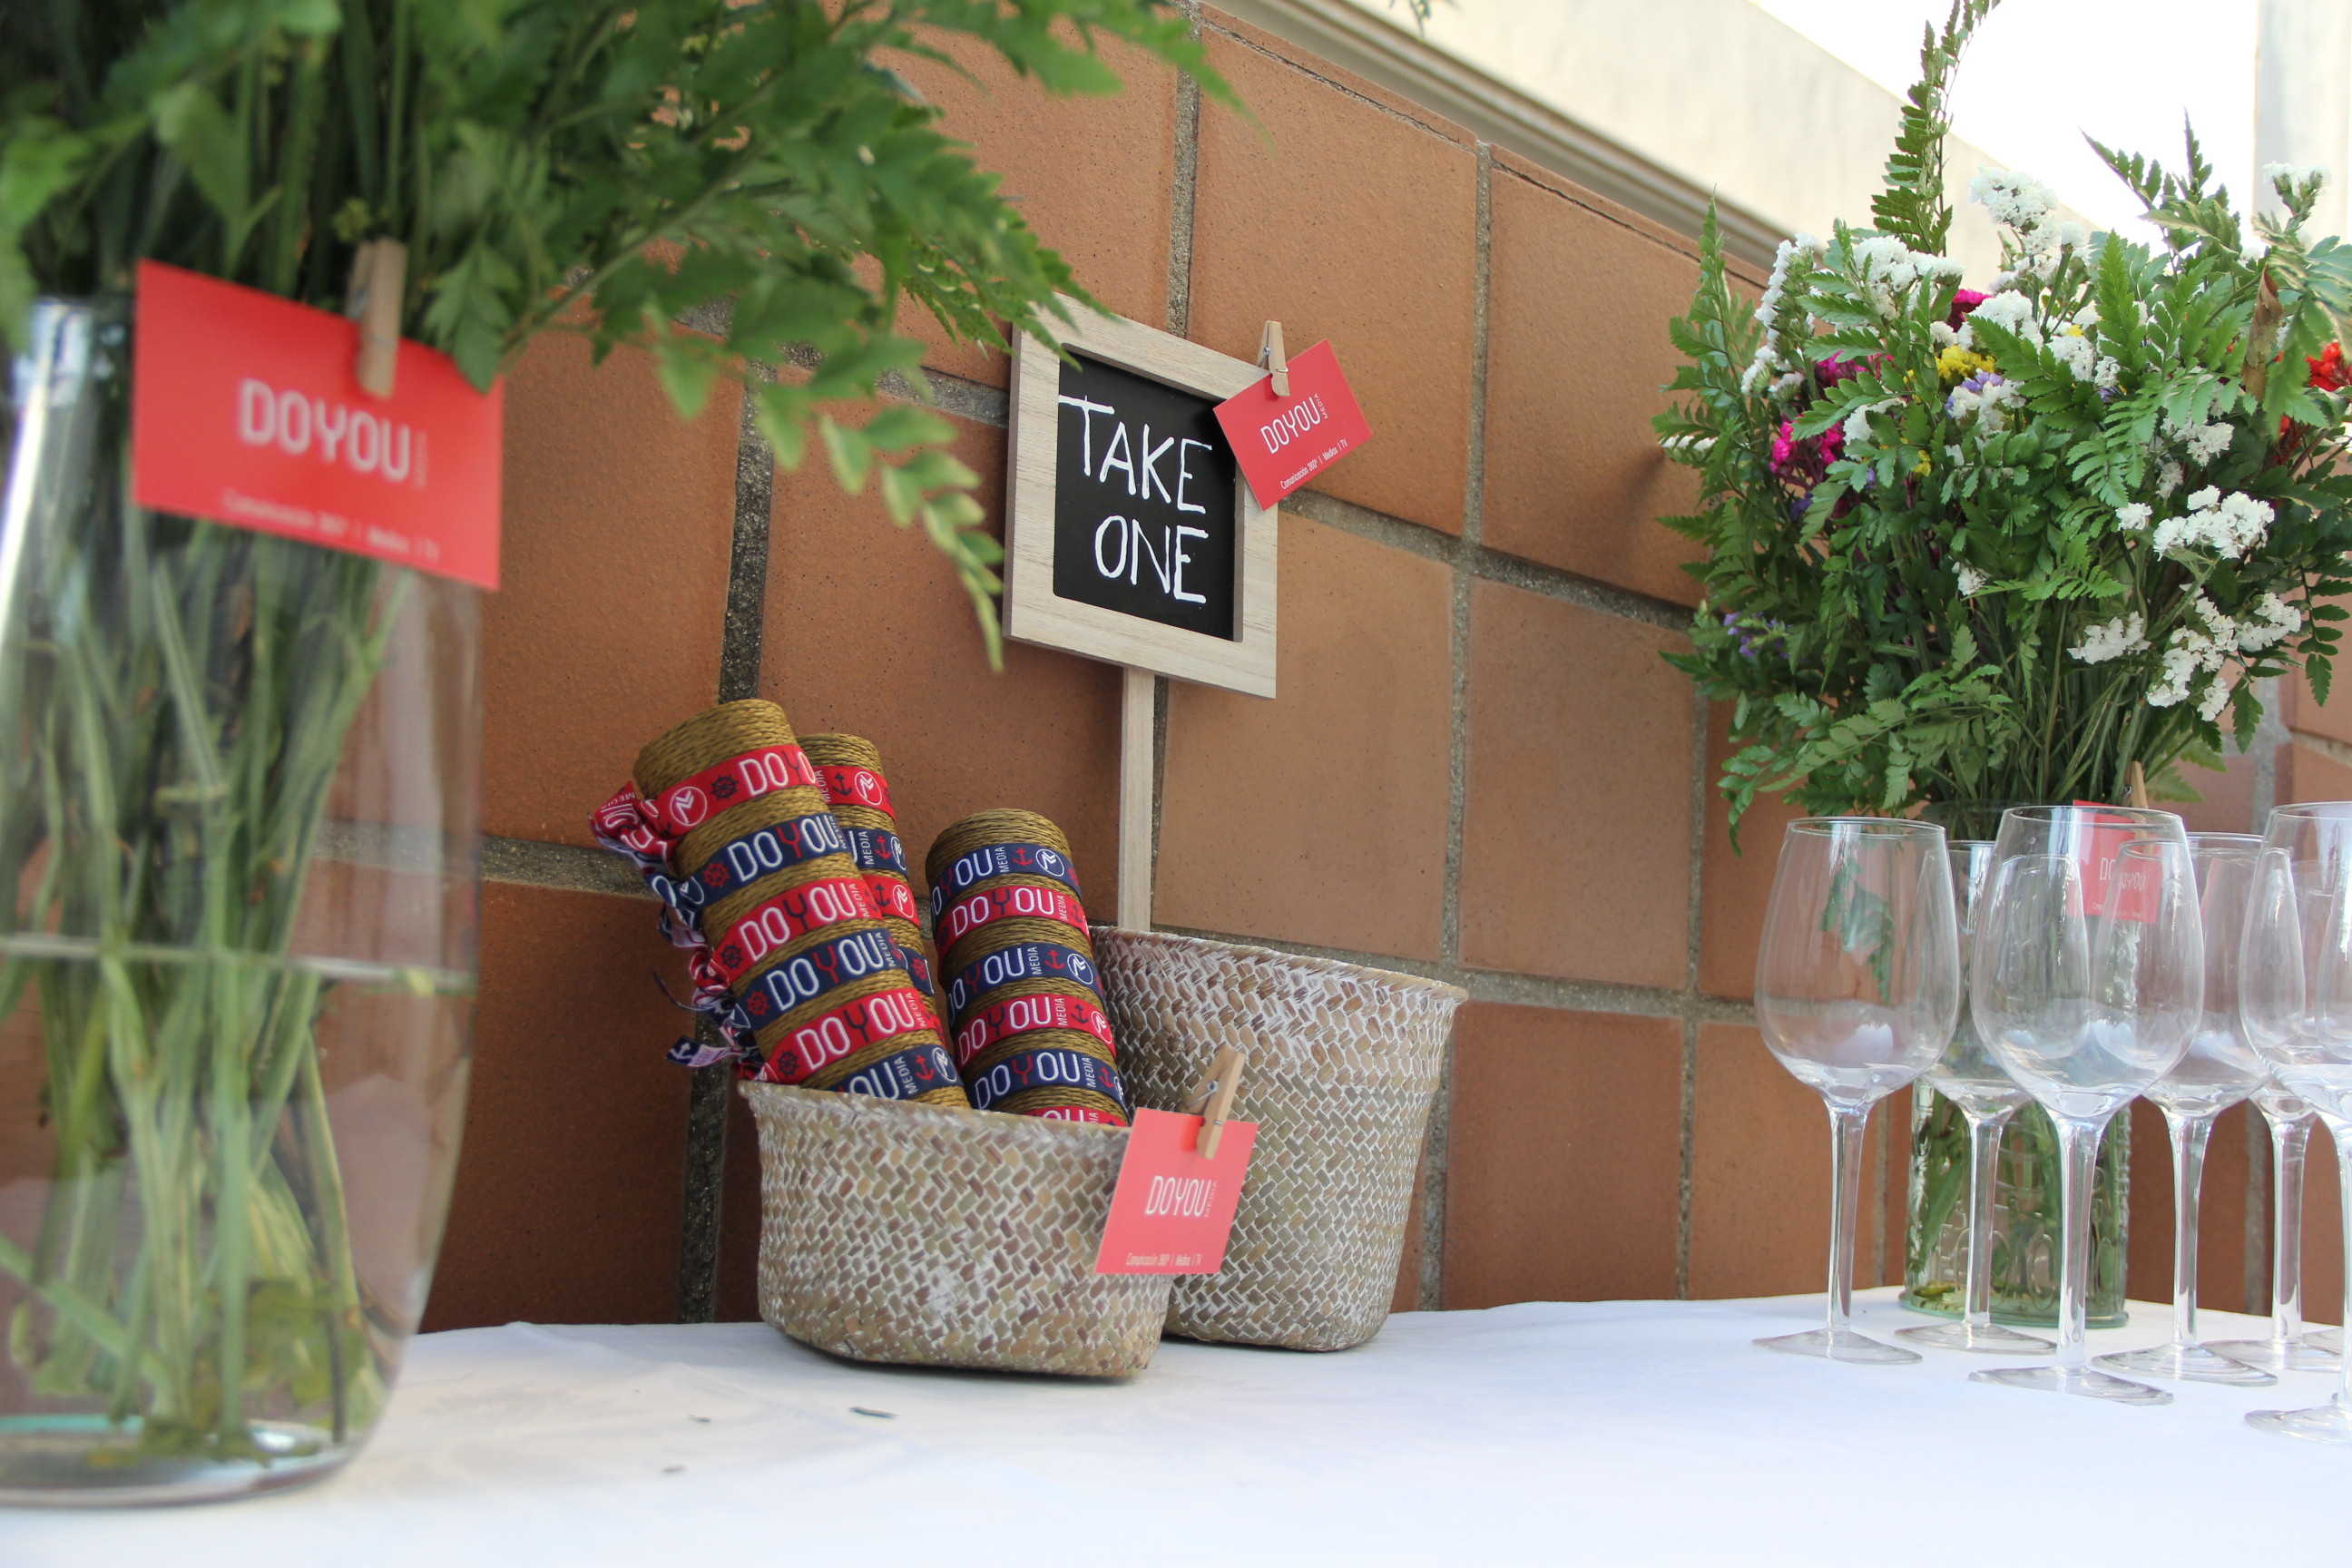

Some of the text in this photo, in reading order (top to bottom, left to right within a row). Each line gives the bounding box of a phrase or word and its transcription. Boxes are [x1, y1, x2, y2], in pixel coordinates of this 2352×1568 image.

[240, 377, 411, 483] DOYOU
[1260, 397, 1321, 454] DOYOU
[1059, 395, 1212, 514] TAKE
[1095, 515, 1209, 603] ONE
[739, 750, 816, 796] DOYO
[727, 814, 838, 881] DOYOU
[858, 830, 875, 865] MEDIA
[995, 846, 1009, 873] MEDIA
[848, 883, 871, 918] MEDIA
[931, 848, 994, 916] OYOU
[740, 881, 857, 962] DOYOU
[952, 887, 1054, 937] DOYOU
[767, 932, 884, 1011] DOYOU
[876, 931, 897, 967] MEDIA
[1028, 946, 1044, 975] MEDIA
[950, 947, 1025, 1010] OYOU
[796, 992, 916, 1070] DOYOU
[906, 991, 926, 1027] MEDIA
[958, 996, 1052, 1065] DOYOU
[1054, 997, 1067, 1026] MEDIA
[894, 1055, 917, 1095] MEDIA
[975, 1052, 1081, 1110] DOYOU
[1082, 1057, 1096, 1088] MEDIA
[1144, 1175, 1211, 1217] DOYOU
